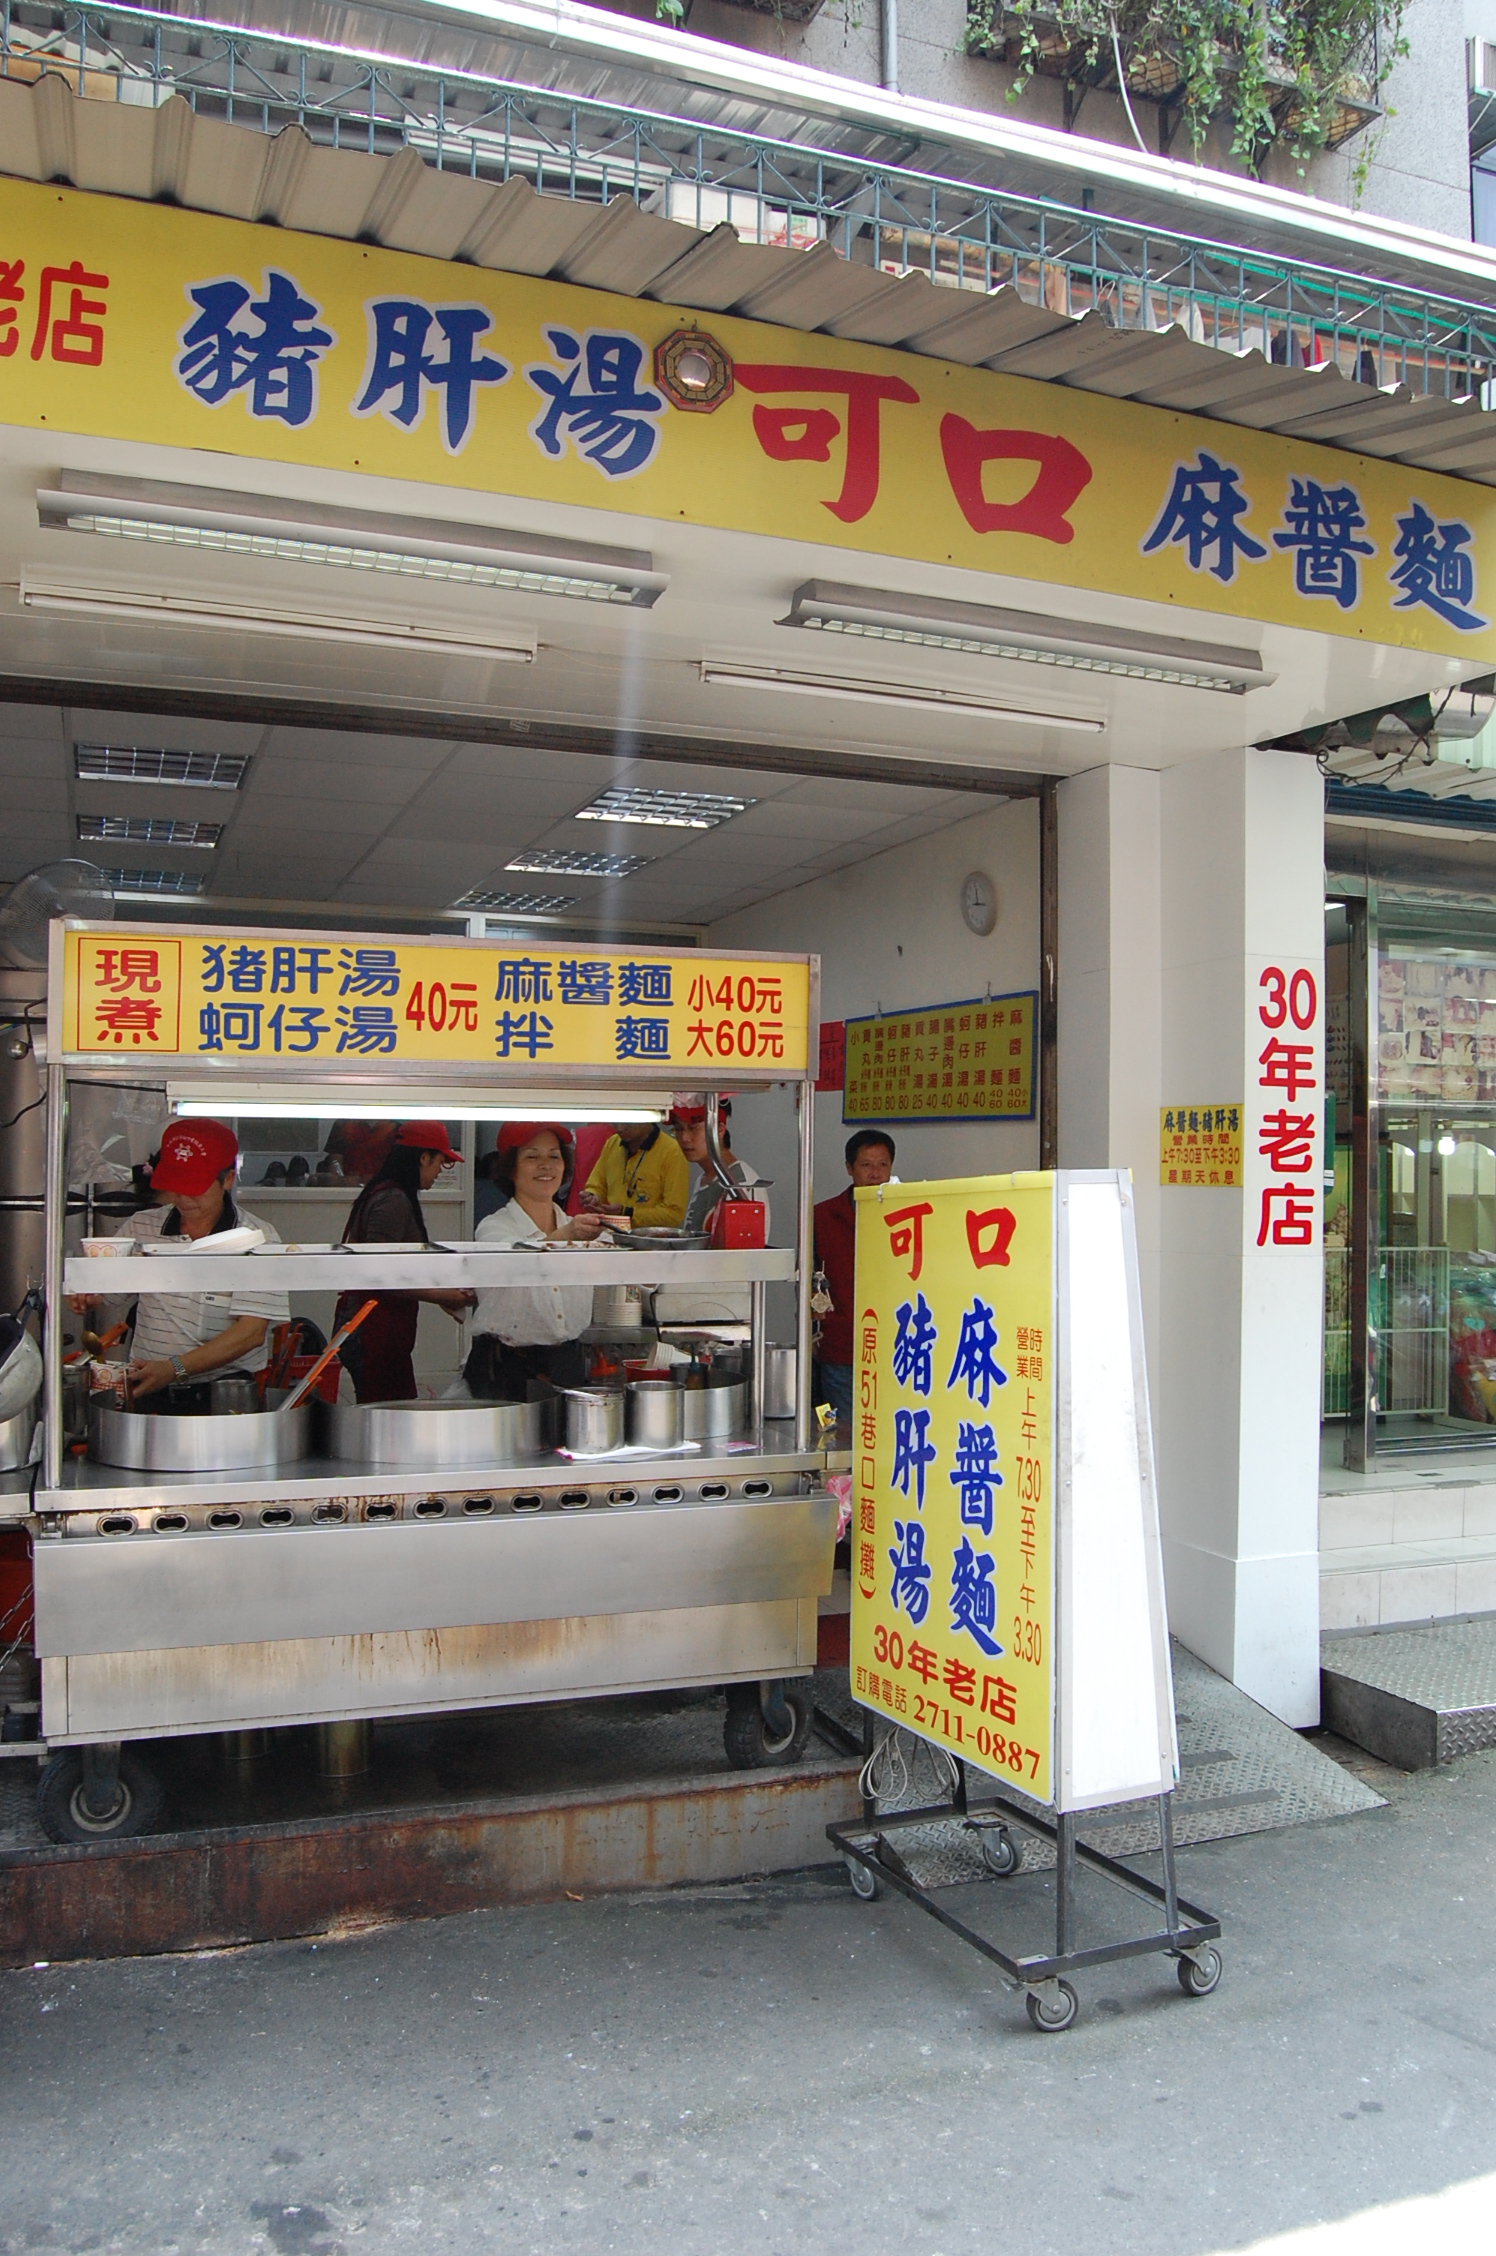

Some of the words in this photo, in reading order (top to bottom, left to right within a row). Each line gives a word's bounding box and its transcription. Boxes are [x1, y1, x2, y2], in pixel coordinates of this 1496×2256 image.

[179, 271, 664, 476] 豬肝湯
[734, 362, 1093, 545] 可口
[1143, 453, 1488, 630] 麻醬麵
[95, 949, 162, 1043] 現煮
[201, 944, 400, 996] 猪肝湯
[405, 980, 479, 1033] 40元
[496, 957, 673, 1006] 麻醬麵
[686, 973, 783, 1015] 小40元
[199, 1001, 397, 1054] 蚵仔湯
[686, 1019, 785, 1059] 大60元
[1257, 966, 1317, 1247] 30年老店
[1168, 1169, 1235, 1185] 星期天休息
[884, 1202, 1017, 1281] 可口
[889, 1291, 937, 1626] 豬肝湯
[946, 1297, 1008, 1657] 麻醬麵
[873, 1624, 1018, 1726] 30年老店
[856, 1665, 907, 1714] 訂購電話
[913, 1694, 1040, 1780] 2711-0887
